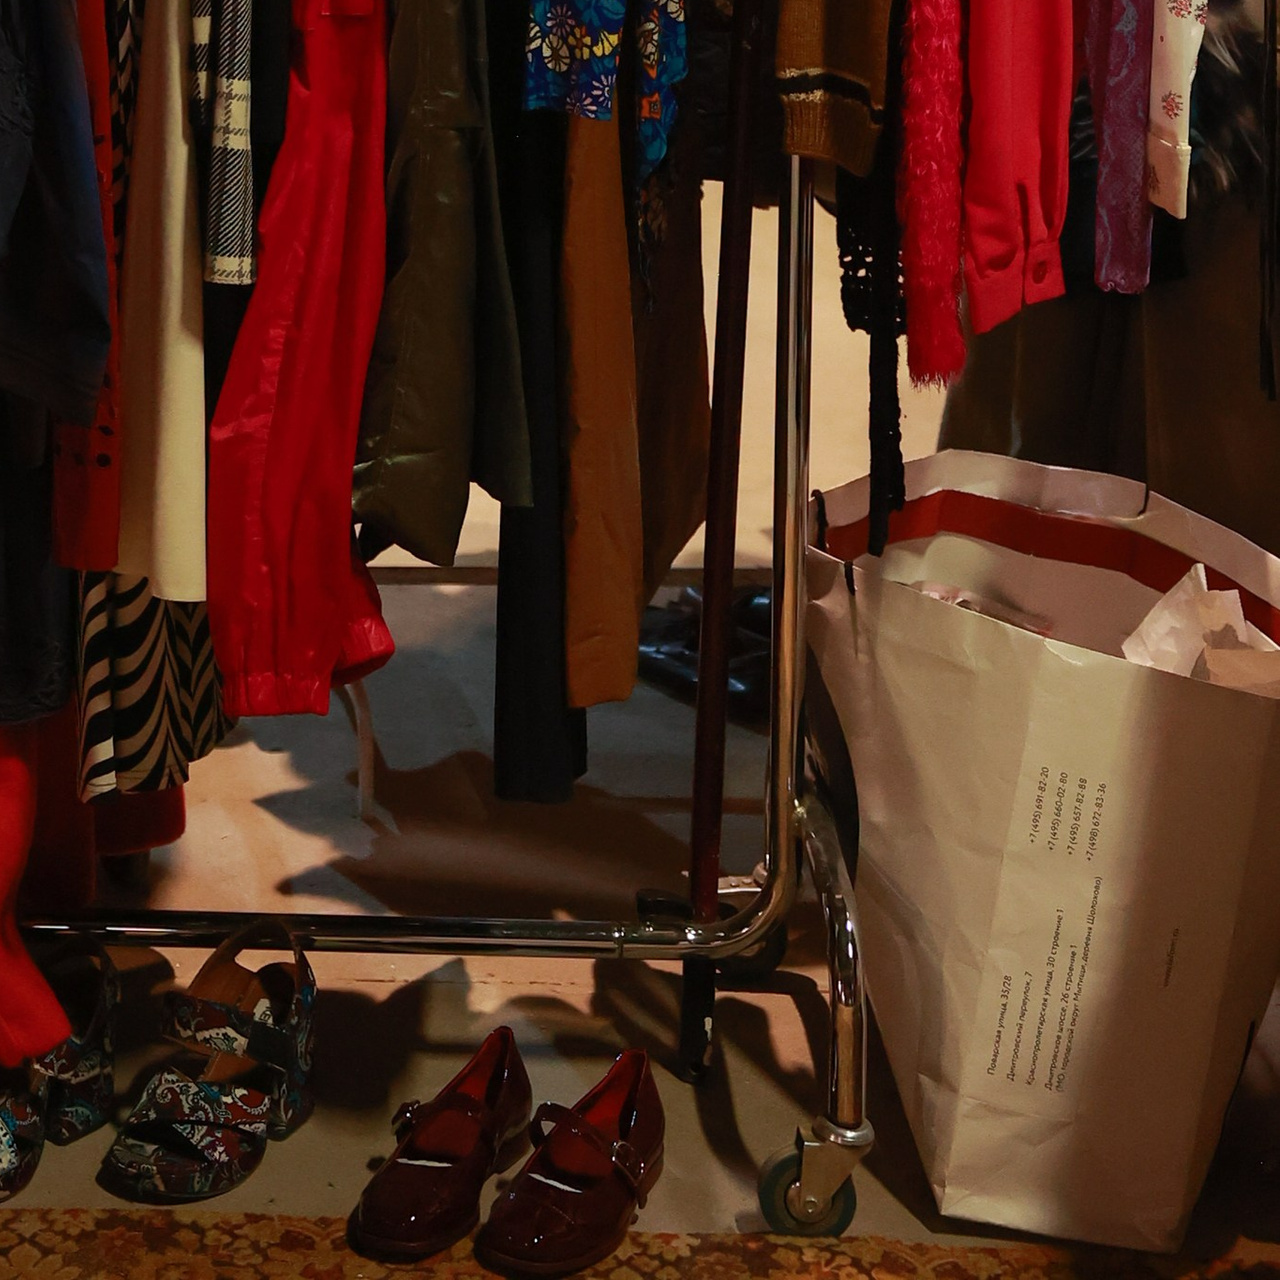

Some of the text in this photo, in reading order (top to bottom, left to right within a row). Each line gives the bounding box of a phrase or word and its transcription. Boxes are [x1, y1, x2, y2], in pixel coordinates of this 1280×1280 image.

[1029, 767, 1049, 843] +7 (495) 691-82-20
[1047, 772, 1068, 850] +7 (495) 660-02-80
[1067, 777, 1087, 855] +7 (495) 657-82-88
[1086, 783, 1107, 861] +7 (498) 672-83-36
[1046, 956, 1056, 968] 30
[1051, 915, 1063, 955] строение
[1060, 992, 1070, 1004] 26
[1065, 951, 1077, 991] строение
[1070, 1003, 1080, 1027] округ
[1086, 876, 1103, 925] Шолохово)
[987, 1030, 1002, 1075] Поварская
[1000, 975, 1012, 1000] 35/28
